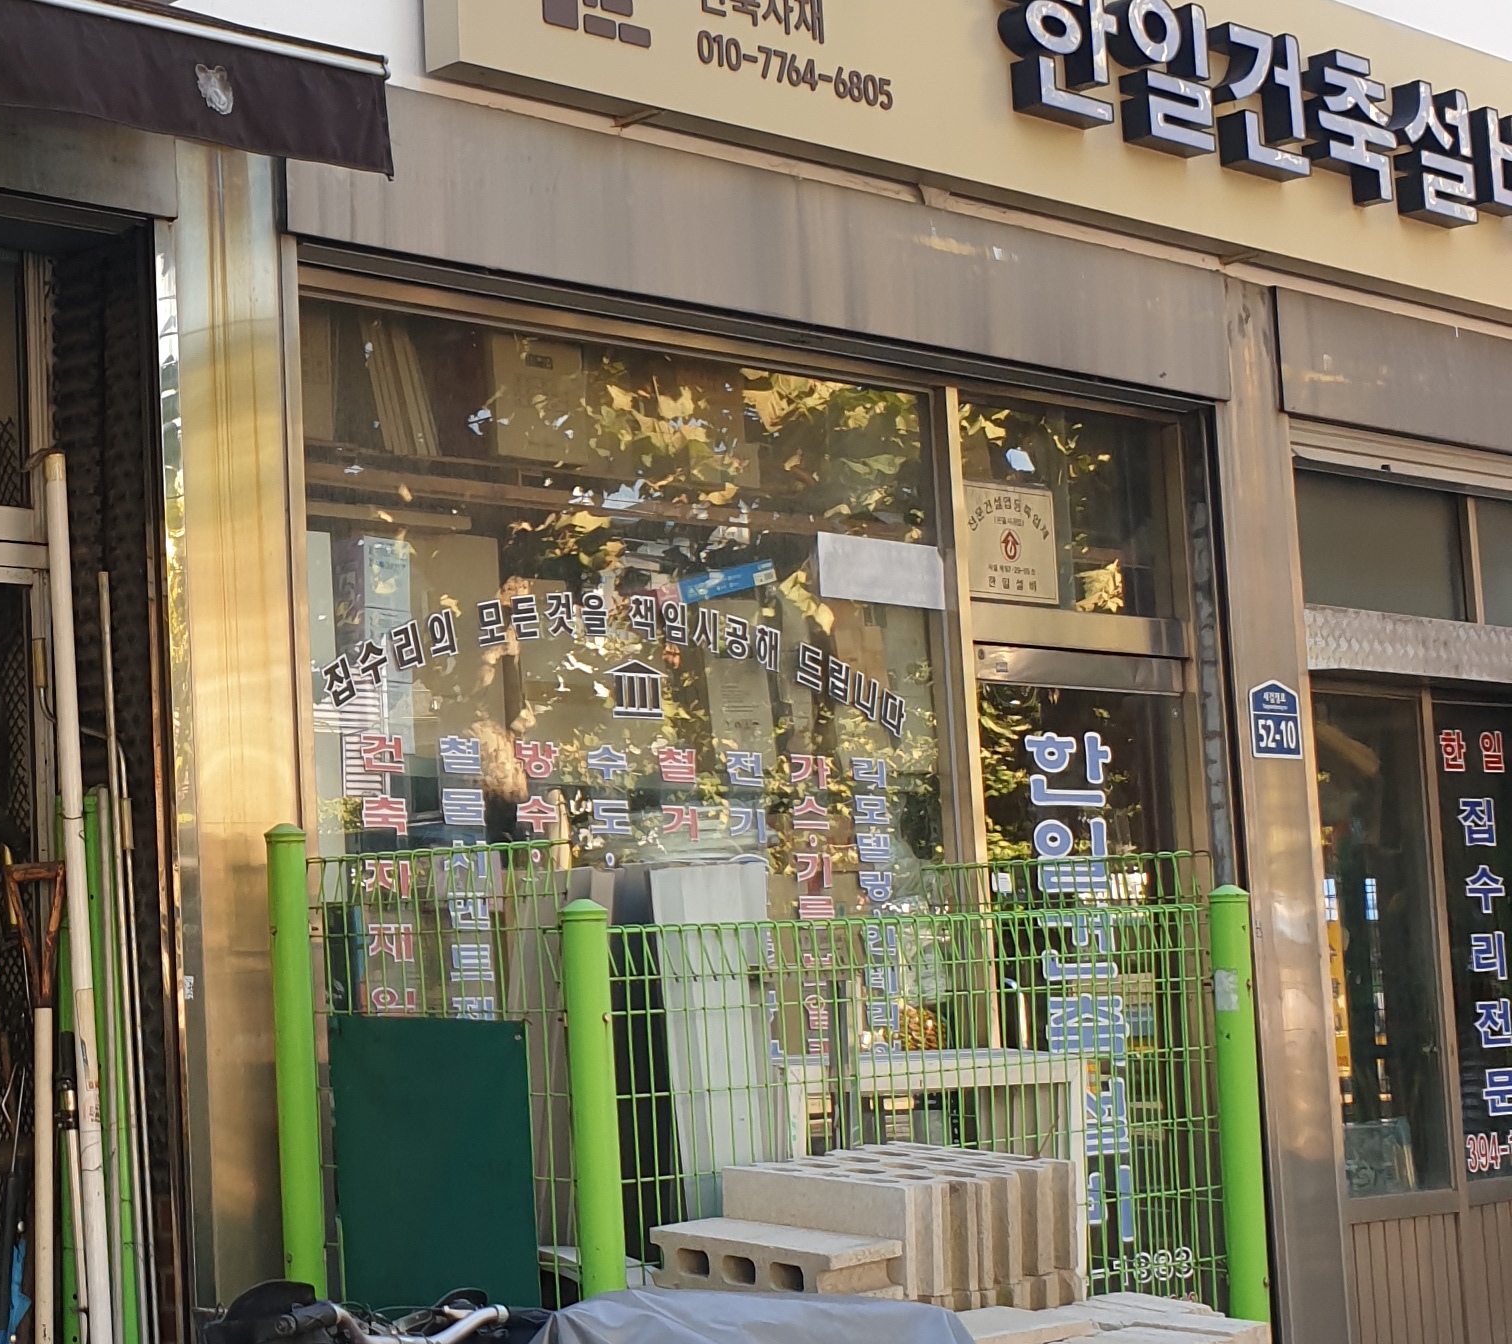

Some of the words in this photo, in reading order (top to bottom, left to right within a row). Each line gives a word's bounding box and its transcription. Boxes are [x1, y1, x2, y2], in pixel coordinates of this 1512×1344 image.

[697, 29, 894, 111] 010-7764-6805
[322, 608, 459, 708] 집수리의
[476, 591, 609, 647] 모든것을
[628, 594, 781, 672] 책임시공해
[796, 641, 907, 738] 드립니다
[1257, 719, 1296, 749] 52-10
[1466, 1130, 1512, 1173] 394-
